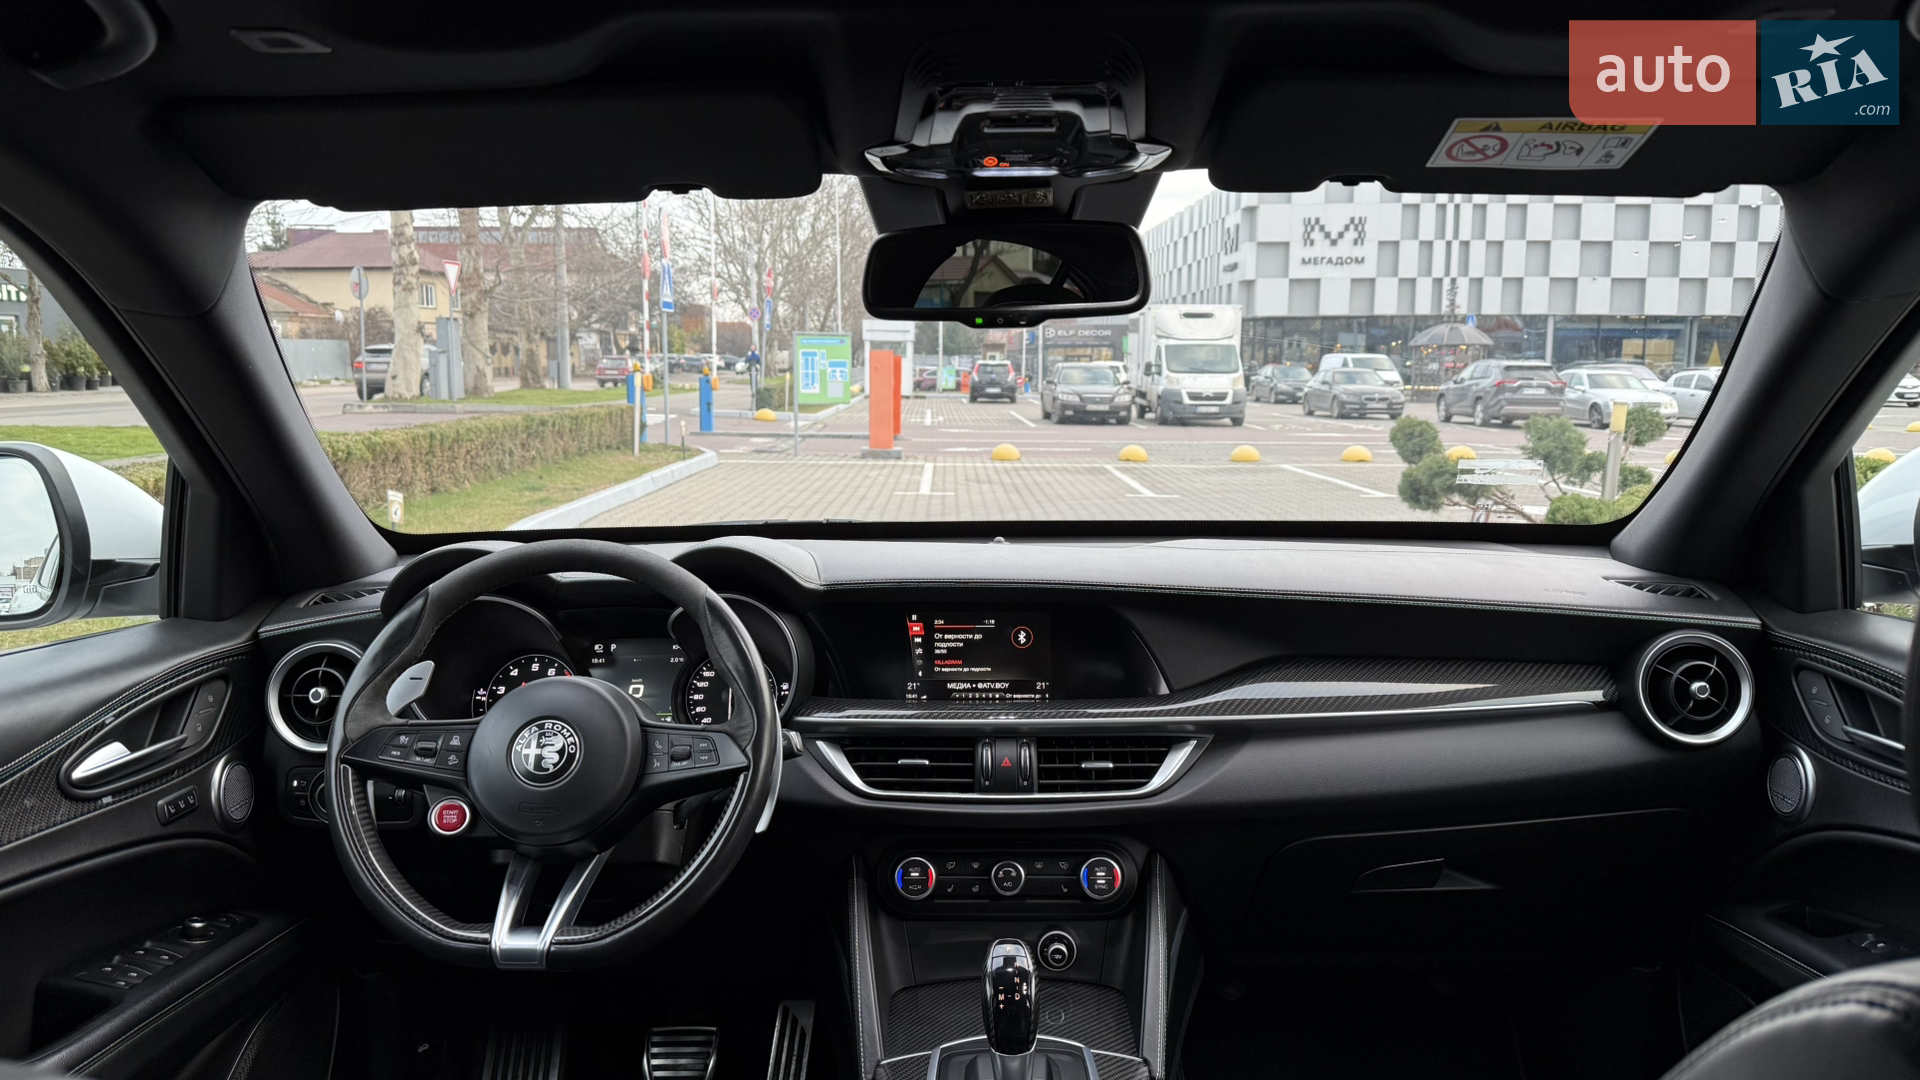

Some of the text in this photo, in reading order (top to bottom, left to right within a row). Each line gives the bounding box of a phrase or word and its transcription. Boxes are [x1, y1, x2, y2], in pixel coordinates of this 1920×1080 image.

[1538, 121, 1627, 132] AIRBAG
[1301, 256, 1365, 266] МЕГАДОМ
[1057, 329, 1112, 337] ELF DECOR
[531, 663, 540, 671] 5
[509, 668, 519, 676] 4
[547, 668, 556, 676] 6
[496, 686, 506, 694] 3
[628, 684, 645, 698] 0
[515, 722, 576, 754] ALFA ROMEO
